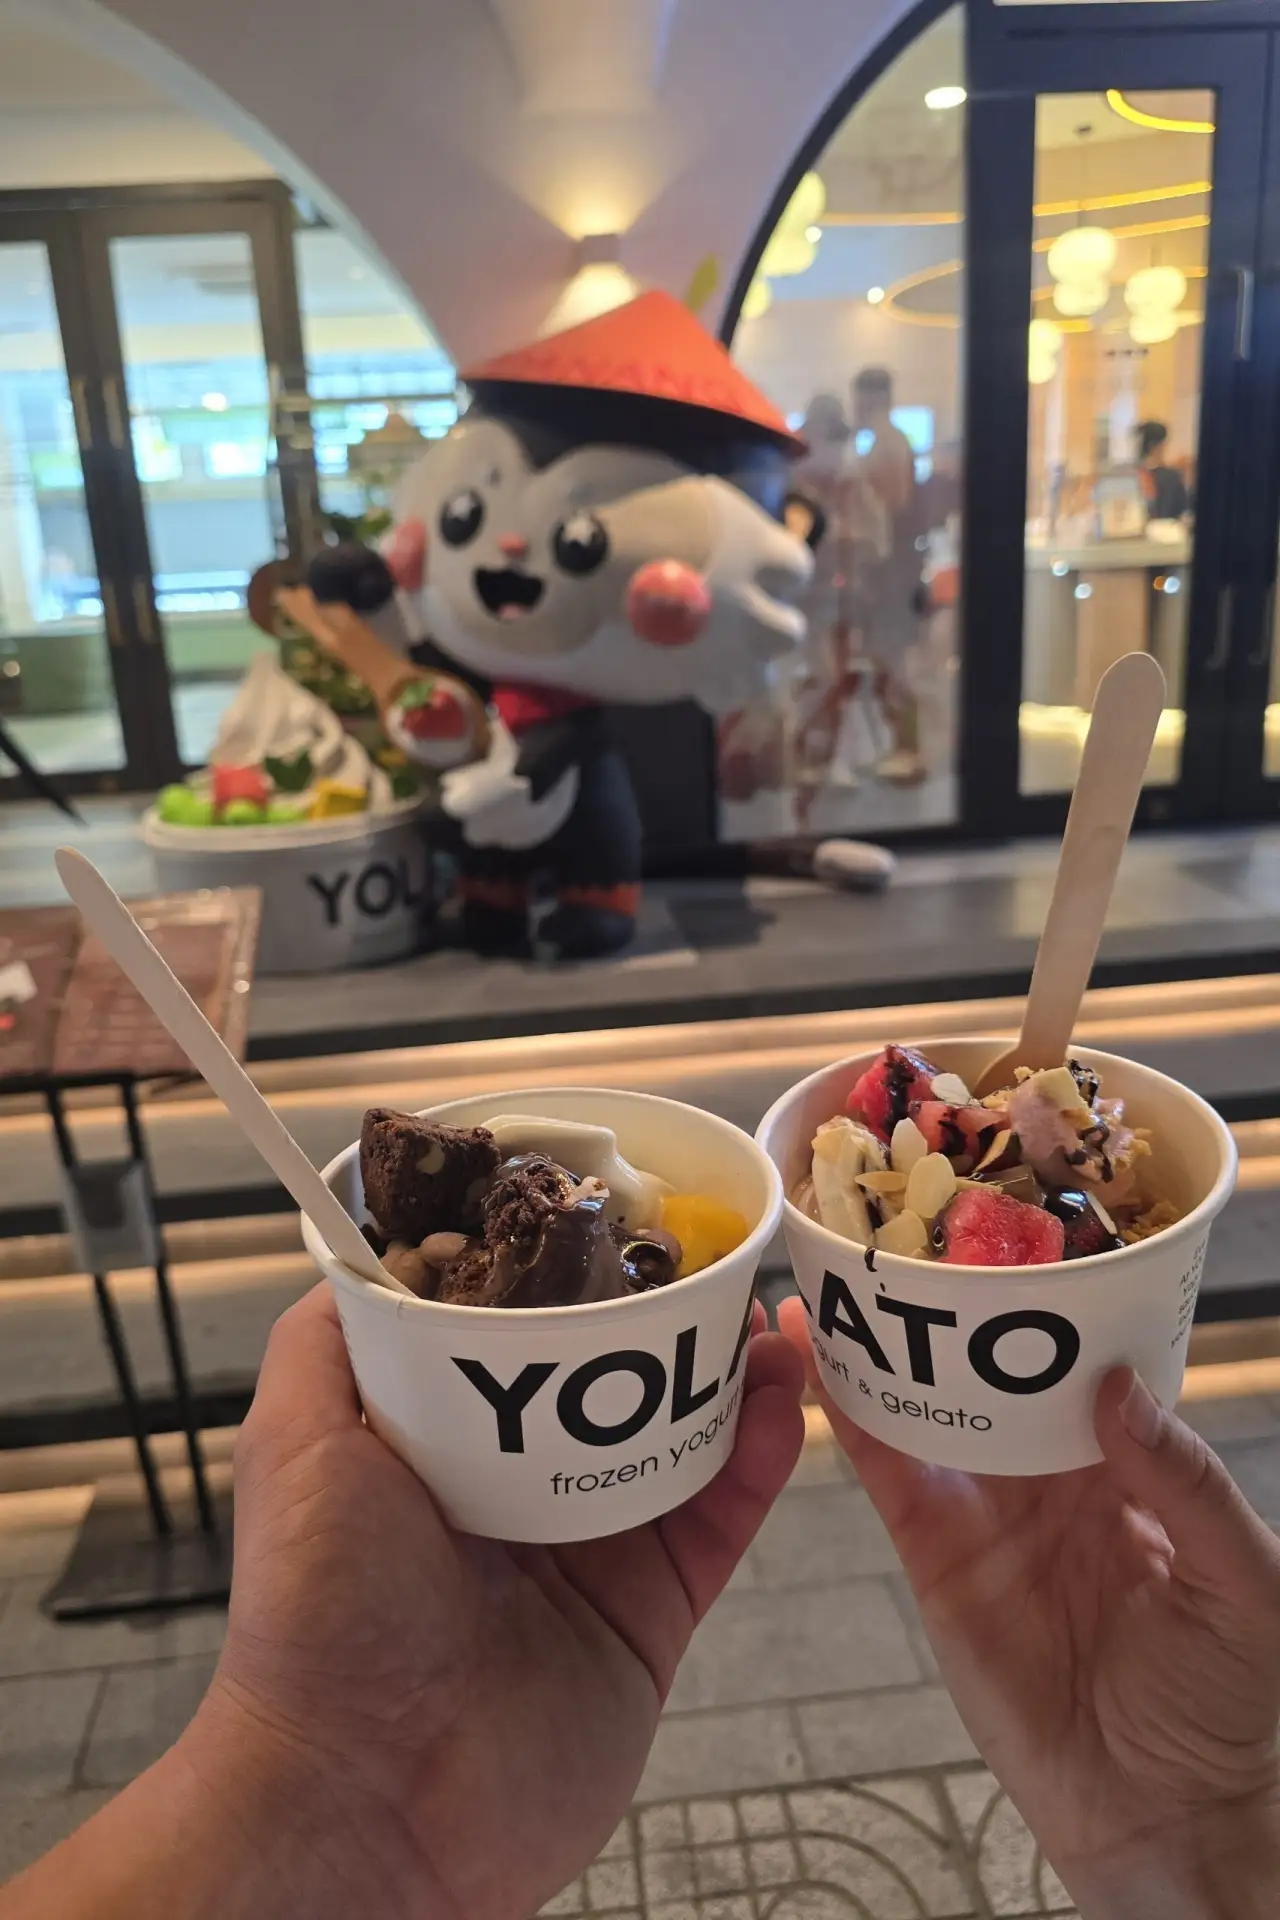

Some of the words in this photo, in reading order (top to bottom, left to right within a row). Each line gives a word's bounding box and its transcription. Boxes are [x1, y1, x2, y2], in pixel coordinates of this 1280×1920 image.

[799, 1269, 1080, 1395] ATO
[550, 1455, 659, 1495] frozen
[669, 1384, 739, 1468] yogurt
[858, 1378, 874, 1398] &
[881, 1391, 992, 1431] gelato
